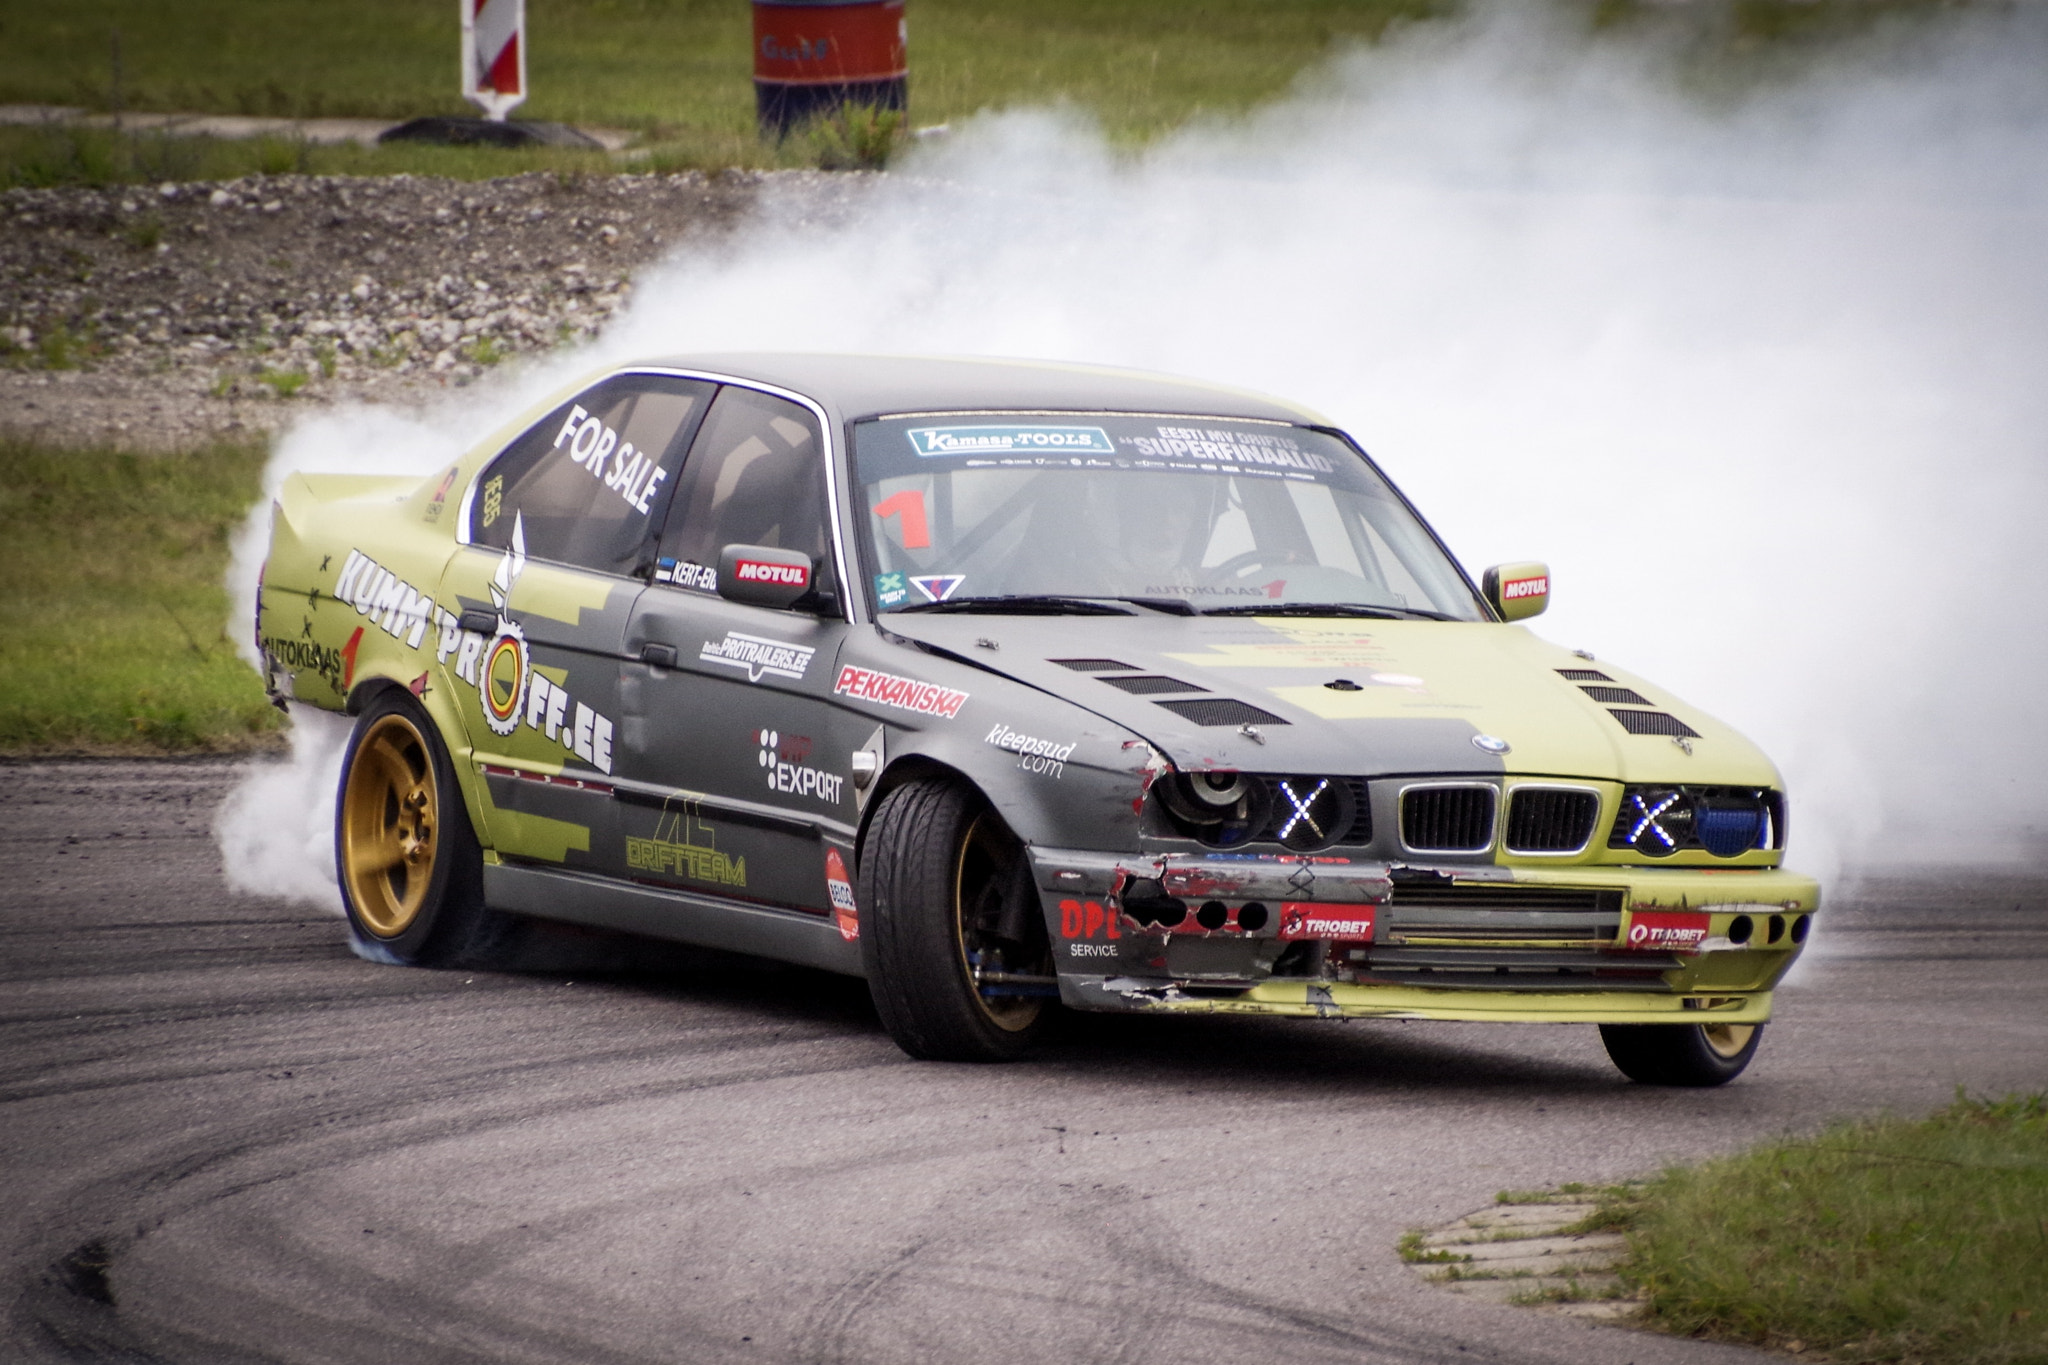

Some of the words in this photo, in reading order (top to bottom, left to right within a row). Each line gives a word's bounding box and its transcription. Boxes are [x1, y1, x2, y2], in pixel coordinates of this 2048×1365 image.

[924, 431, 1091, 450] Kamasa-TOOLS
[1157, 426, 1207, 441] EESTI
[1208, 430, 1235, 443] MV
[1235, 432, 1299, 450] DRIFTIS
[553, 403, 617, 478] FOR
[604, 442, 667, 516] SALE
[872, 490, 931, 550] 1
[738, 564, 804, 583] MOTUL
[1506, 578, 1547, 598] MOTUL
[720, 637, 812, 673] PROTRAILERS.EE
[835, 666, 967, 718] PEKKANISKA
[984, 723, 1078, 762] kleepsud
[1016, 754, 1065, 780] .com
[777, 762, 843, 805] EXPORT
[626, 835, 747, 887] DRIFTTEAM
[1306, 919, 1371, 933] TRIOBET
[1070, 943, 1119, 957] SERVICE
